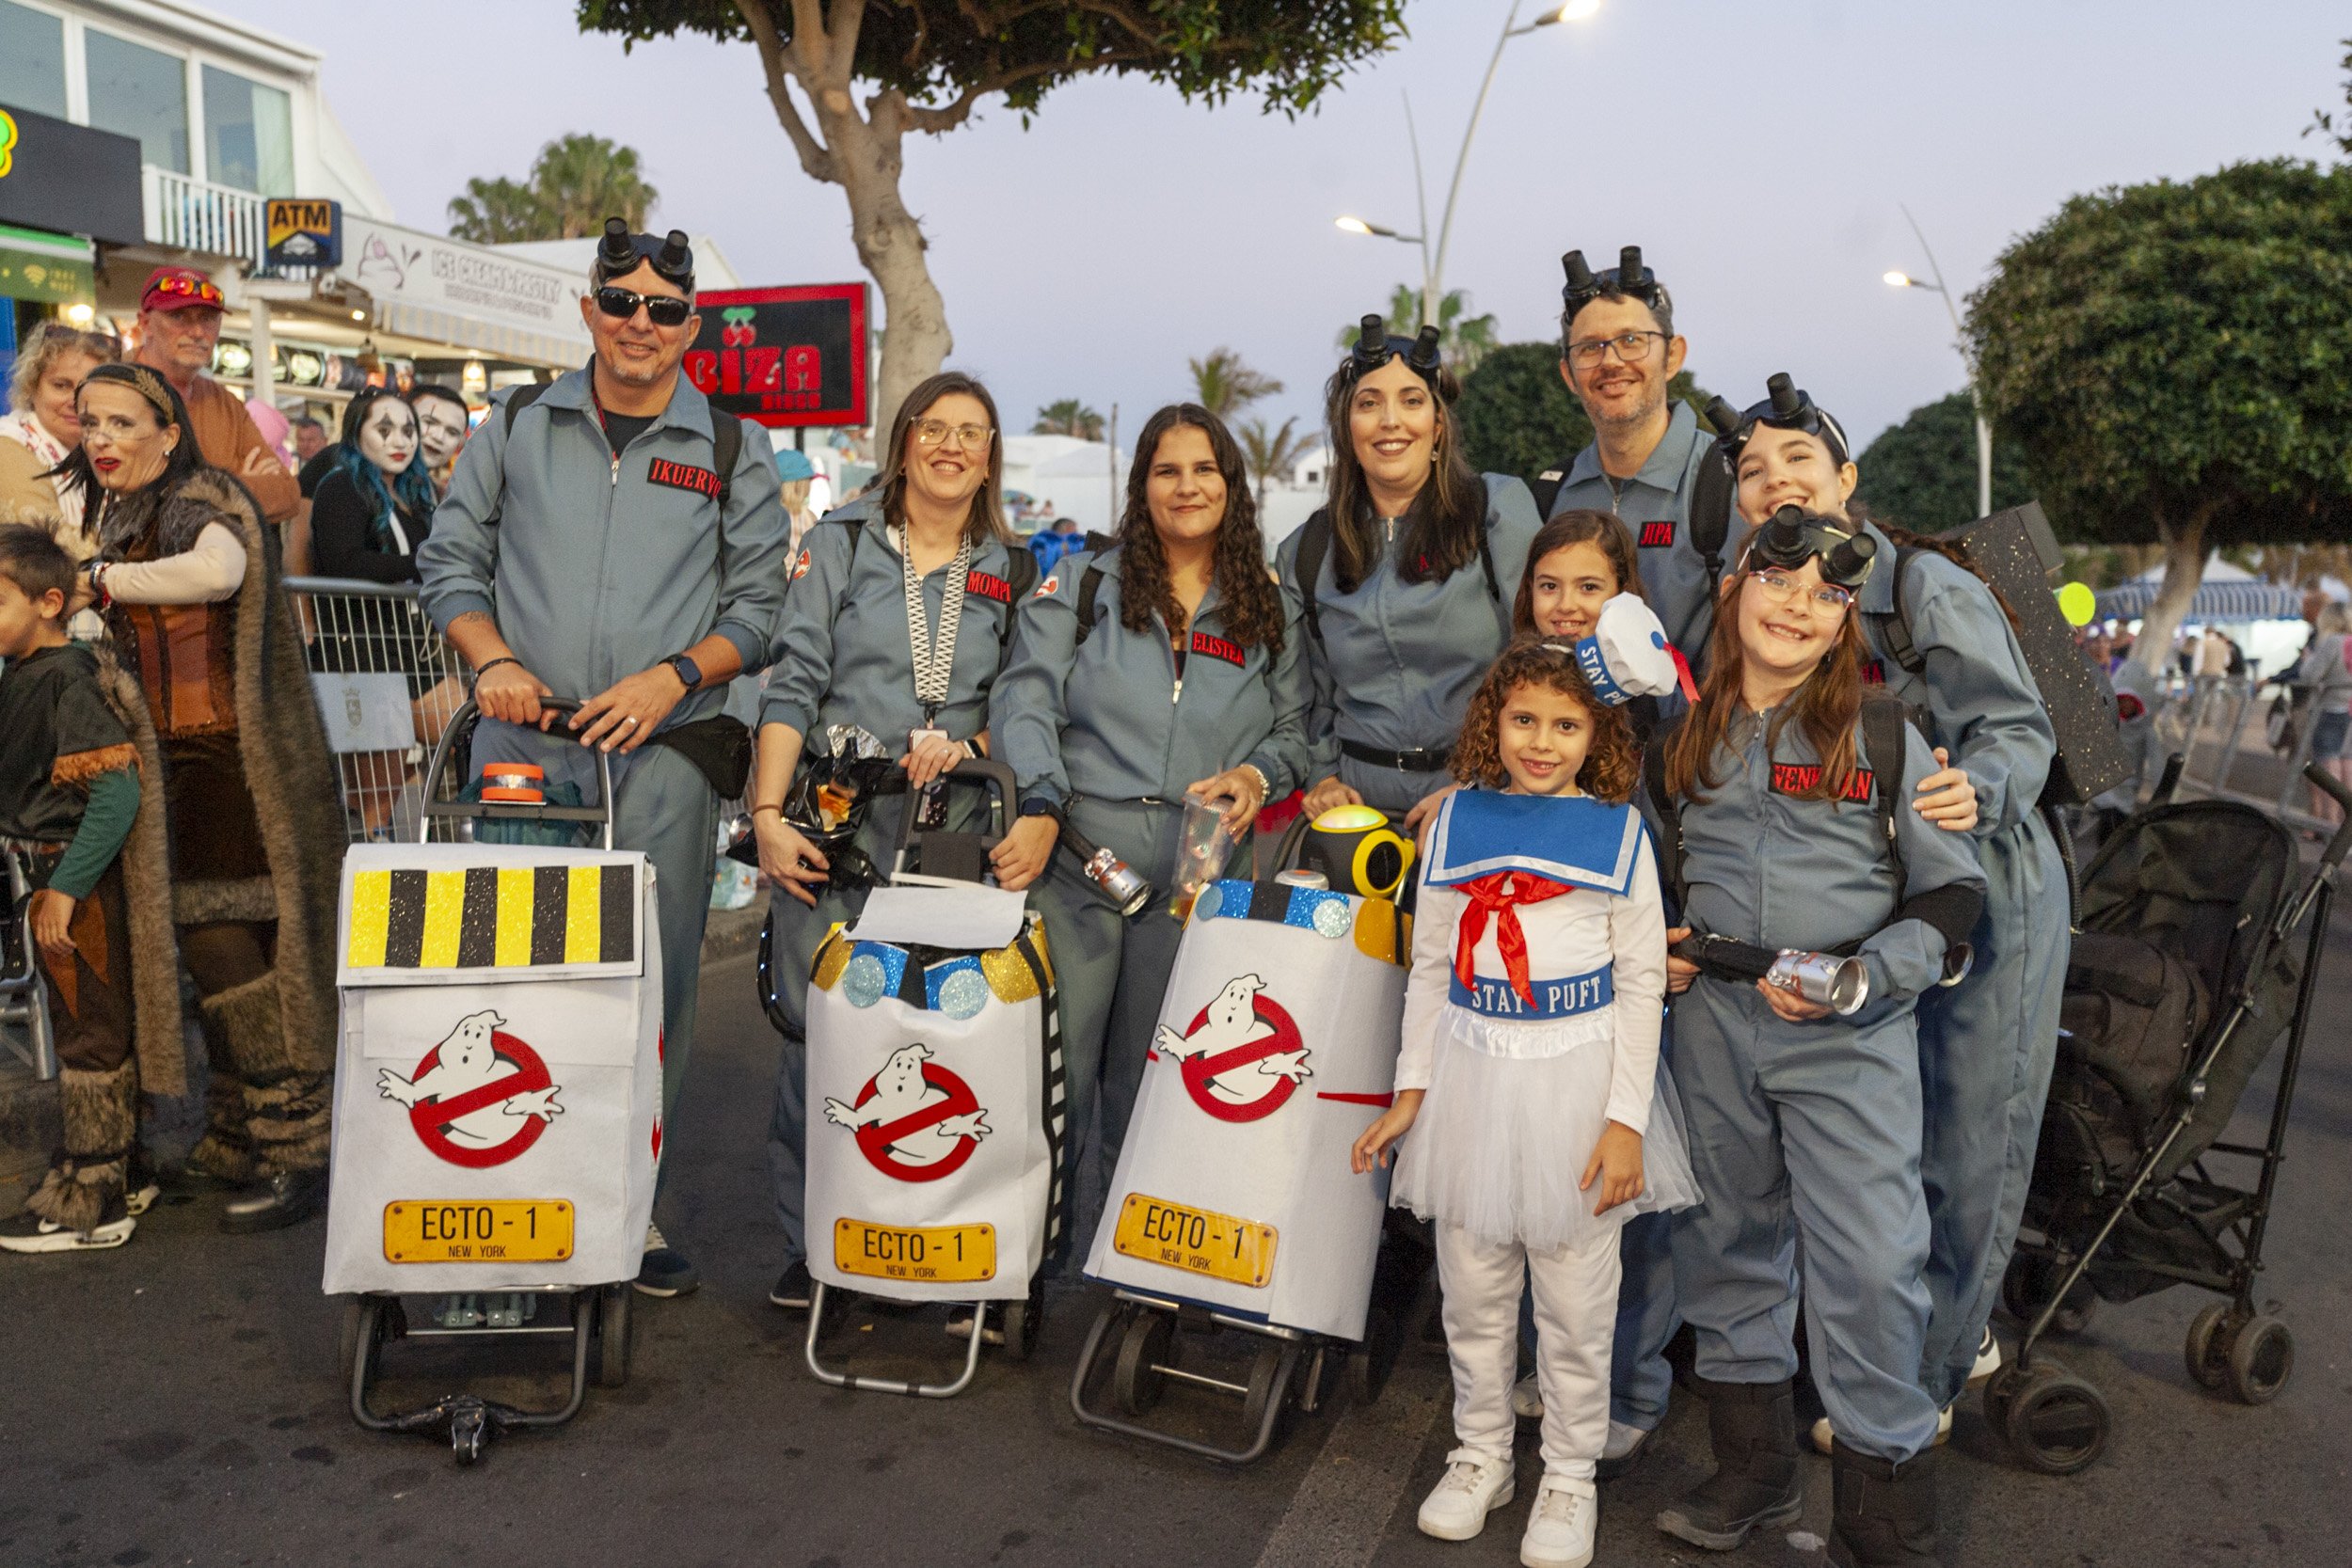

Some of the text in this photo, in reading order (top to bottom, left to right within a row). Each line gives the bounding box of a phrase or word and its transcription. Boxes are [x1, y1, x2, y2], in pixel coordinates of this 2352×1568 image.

[273, 205, 326, 227] ATM
[1581, 646, 1608, 686] STAY
[1471, 975, 1600, 1013] STAY PUFT
[422, 1207, 493, 1240] ECTO
[526, 1207, 536, 1239] 1
[1143, 1204, 1206, 1249] ECTO
[1233, 1227, 1245, 1259] 1
[448, 1245, 506, 1258] NEW YORK
[864, 1228, 925, 1262] ECTO
[953, 1231, 962, 1261] 1
[1161, 1248, 1212, 1271] NEW YORK
[886, 1265, 937, 1278] NEW YORK
